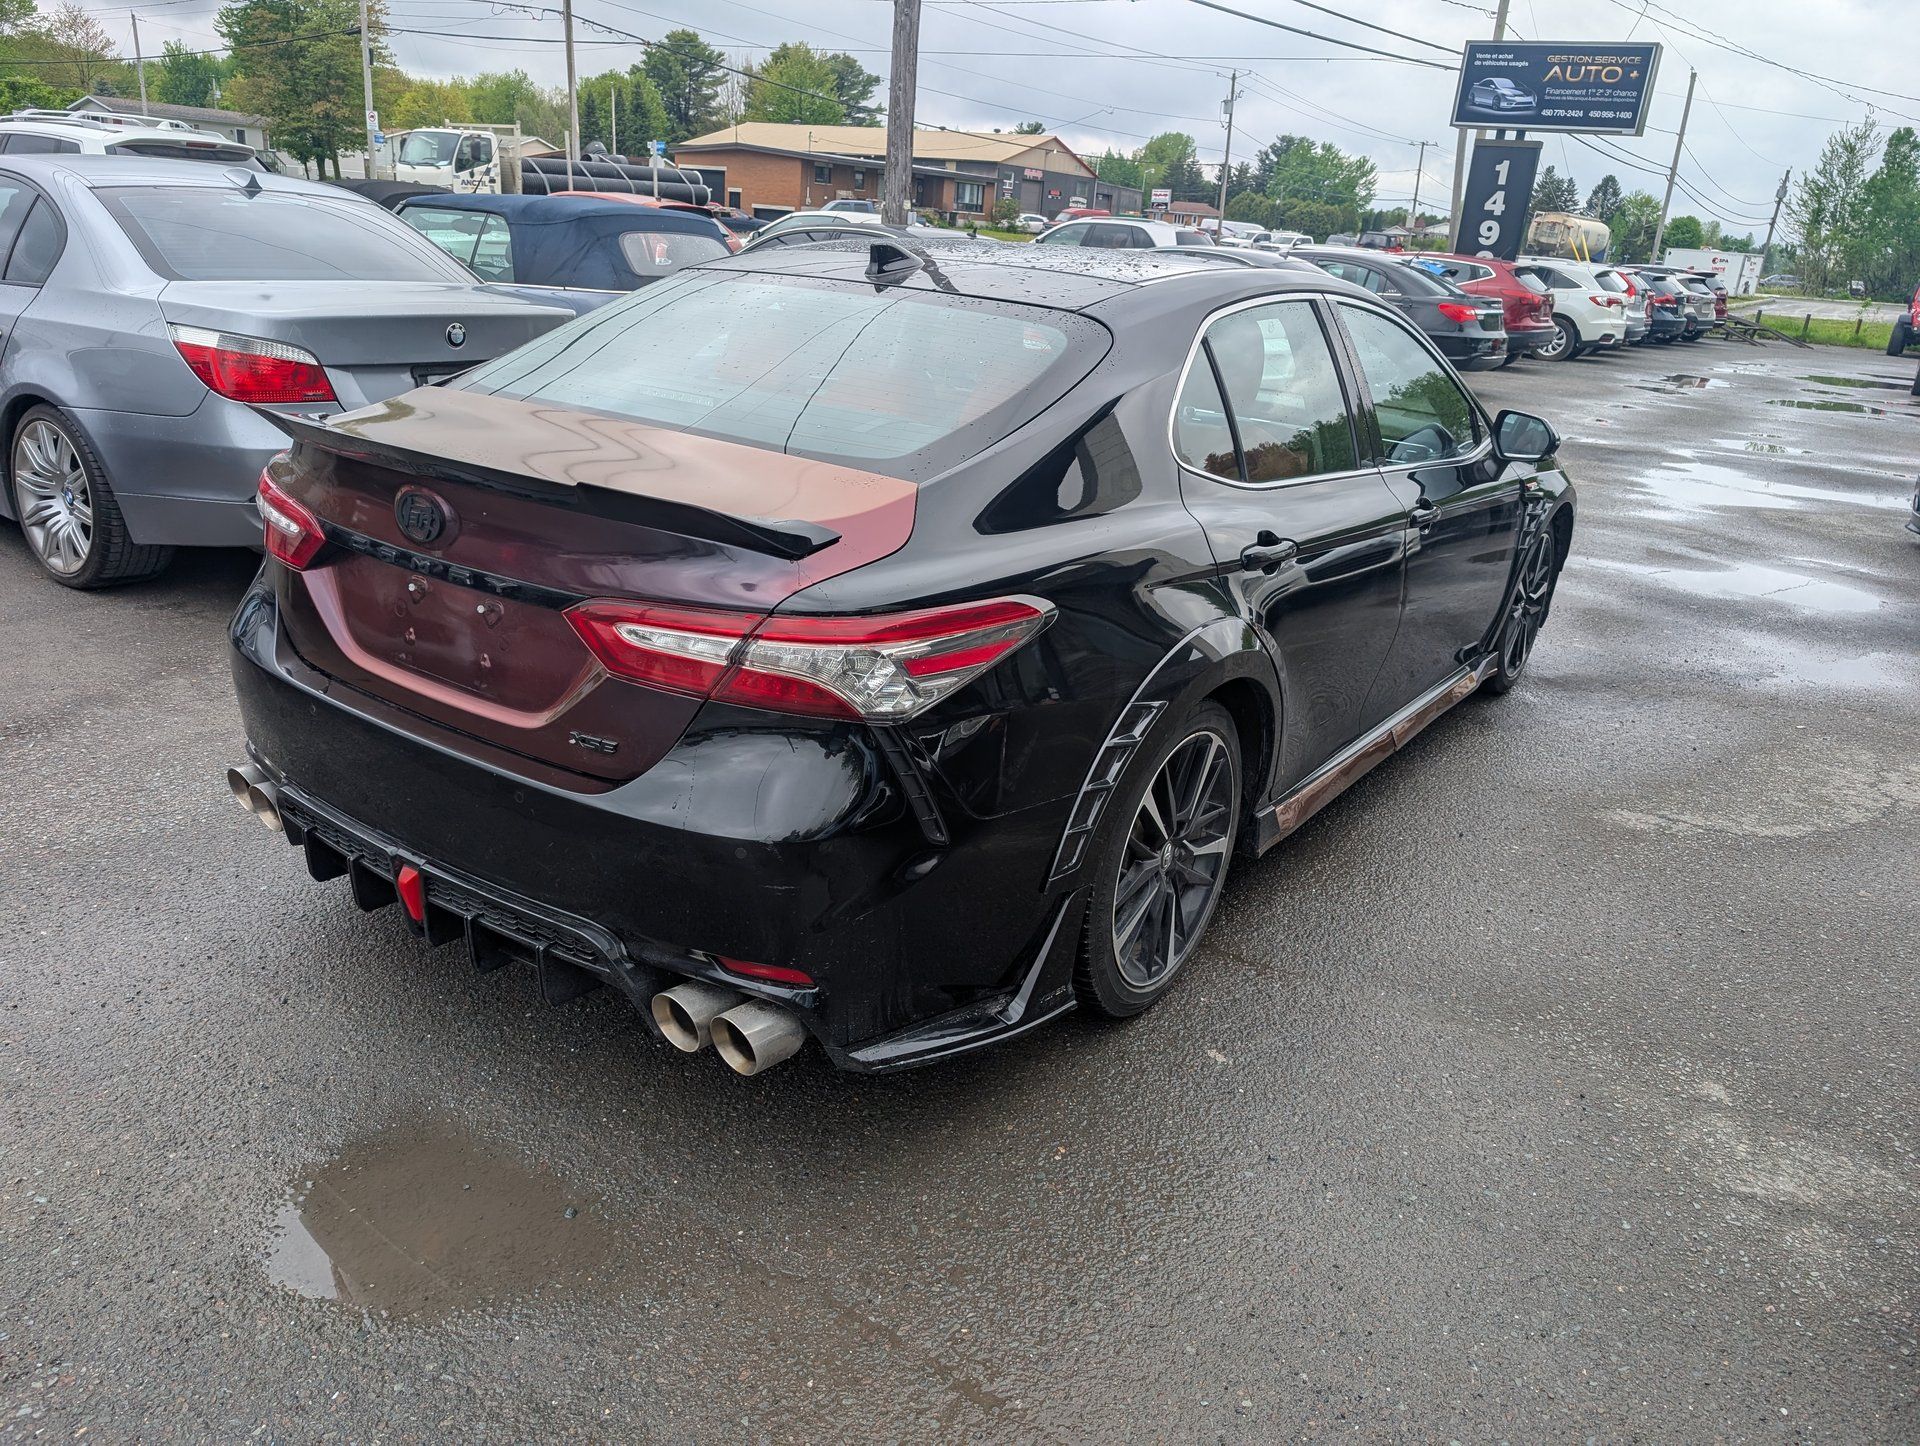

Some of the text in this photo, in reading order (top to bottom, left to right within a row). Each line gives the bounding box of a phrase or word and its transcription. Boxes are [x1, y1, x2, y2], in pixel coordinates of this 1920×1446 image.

[1547, 55, 1642, 64] GESTION SERVICE
[1542, 65, 1623, 83] AUTO
[1545, 87, 1586, 96] Financement
[1541, 109, 1553, 117] 450
[1553, 109, 1583, 117] 770-2424
[1588, 110, 1600, 118] 450
[568, 730, 619, 754] XSE
